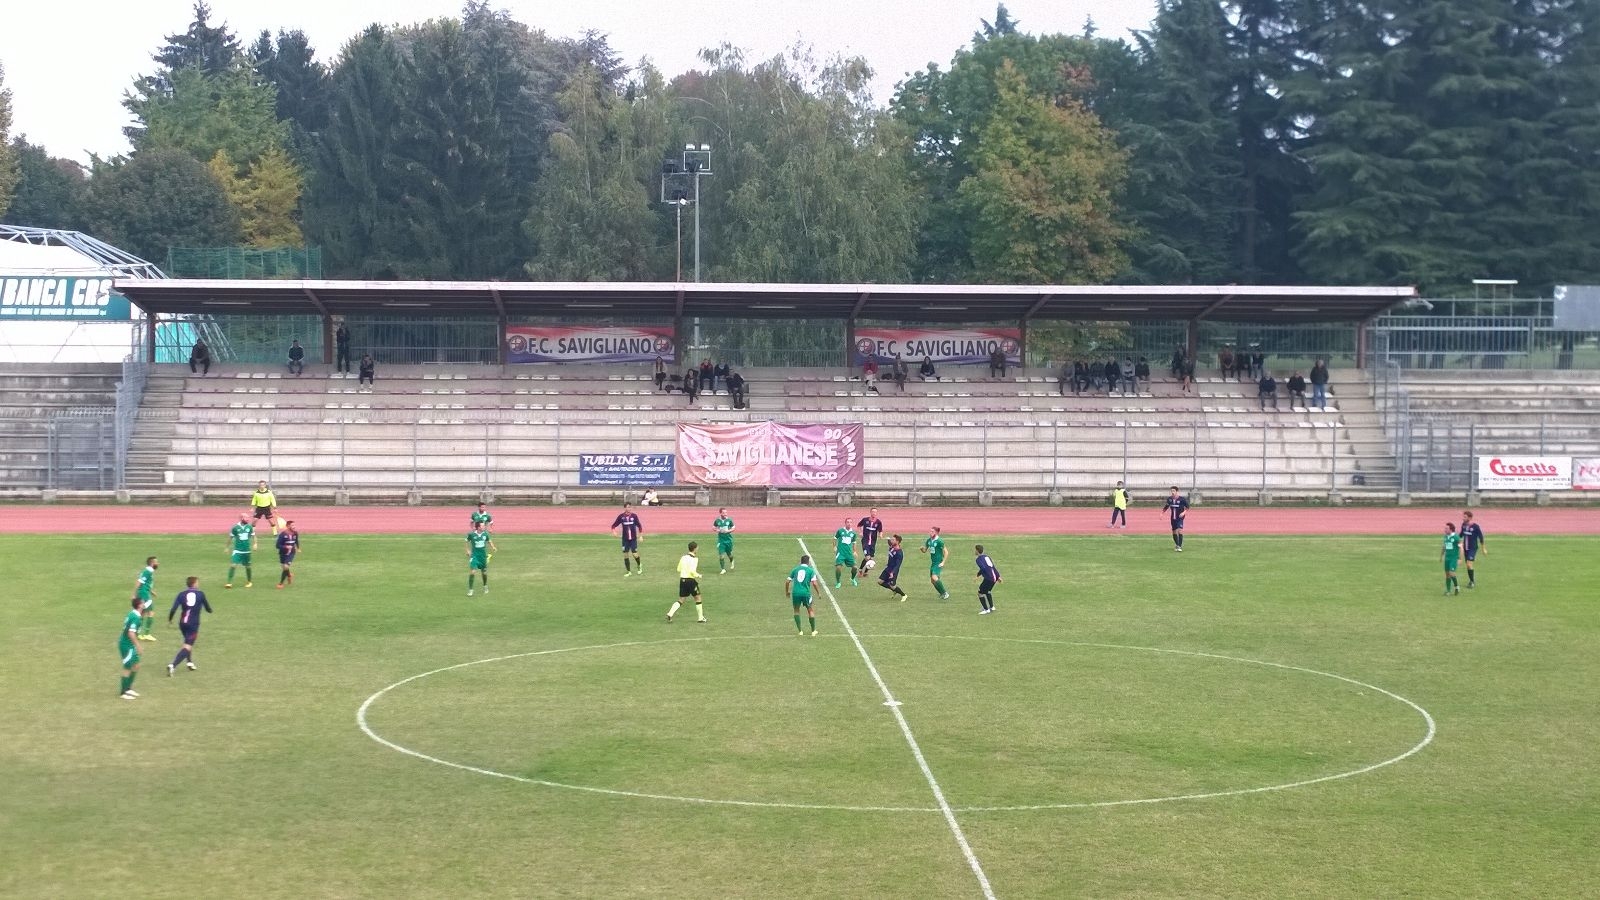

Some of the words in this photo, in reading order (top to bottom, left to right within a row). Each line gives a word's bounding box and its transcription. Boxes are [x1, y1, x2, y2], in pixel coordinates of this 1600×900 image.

[2, 278, 67, 305] BANCA
[72, 278, 113, 305] CRS
[528, 337, 553, 354] F.C.
[558, 337, 650, 354] SAVIGLIANO
[877, 340, 901, 357] F.C.
[906, 340, 998, 357] SAVIGLIANO
[824, 428, 842, 441] 90
[582, 455, 640, 466] TUBILINE
[641, 455, 671, 466] S.r.l.
[706, 442, 839, 467] SAVIGLIANESE
[792, 471, 838, 480] CALCIO
[1489, 458, 1558, 476] Crosetto
